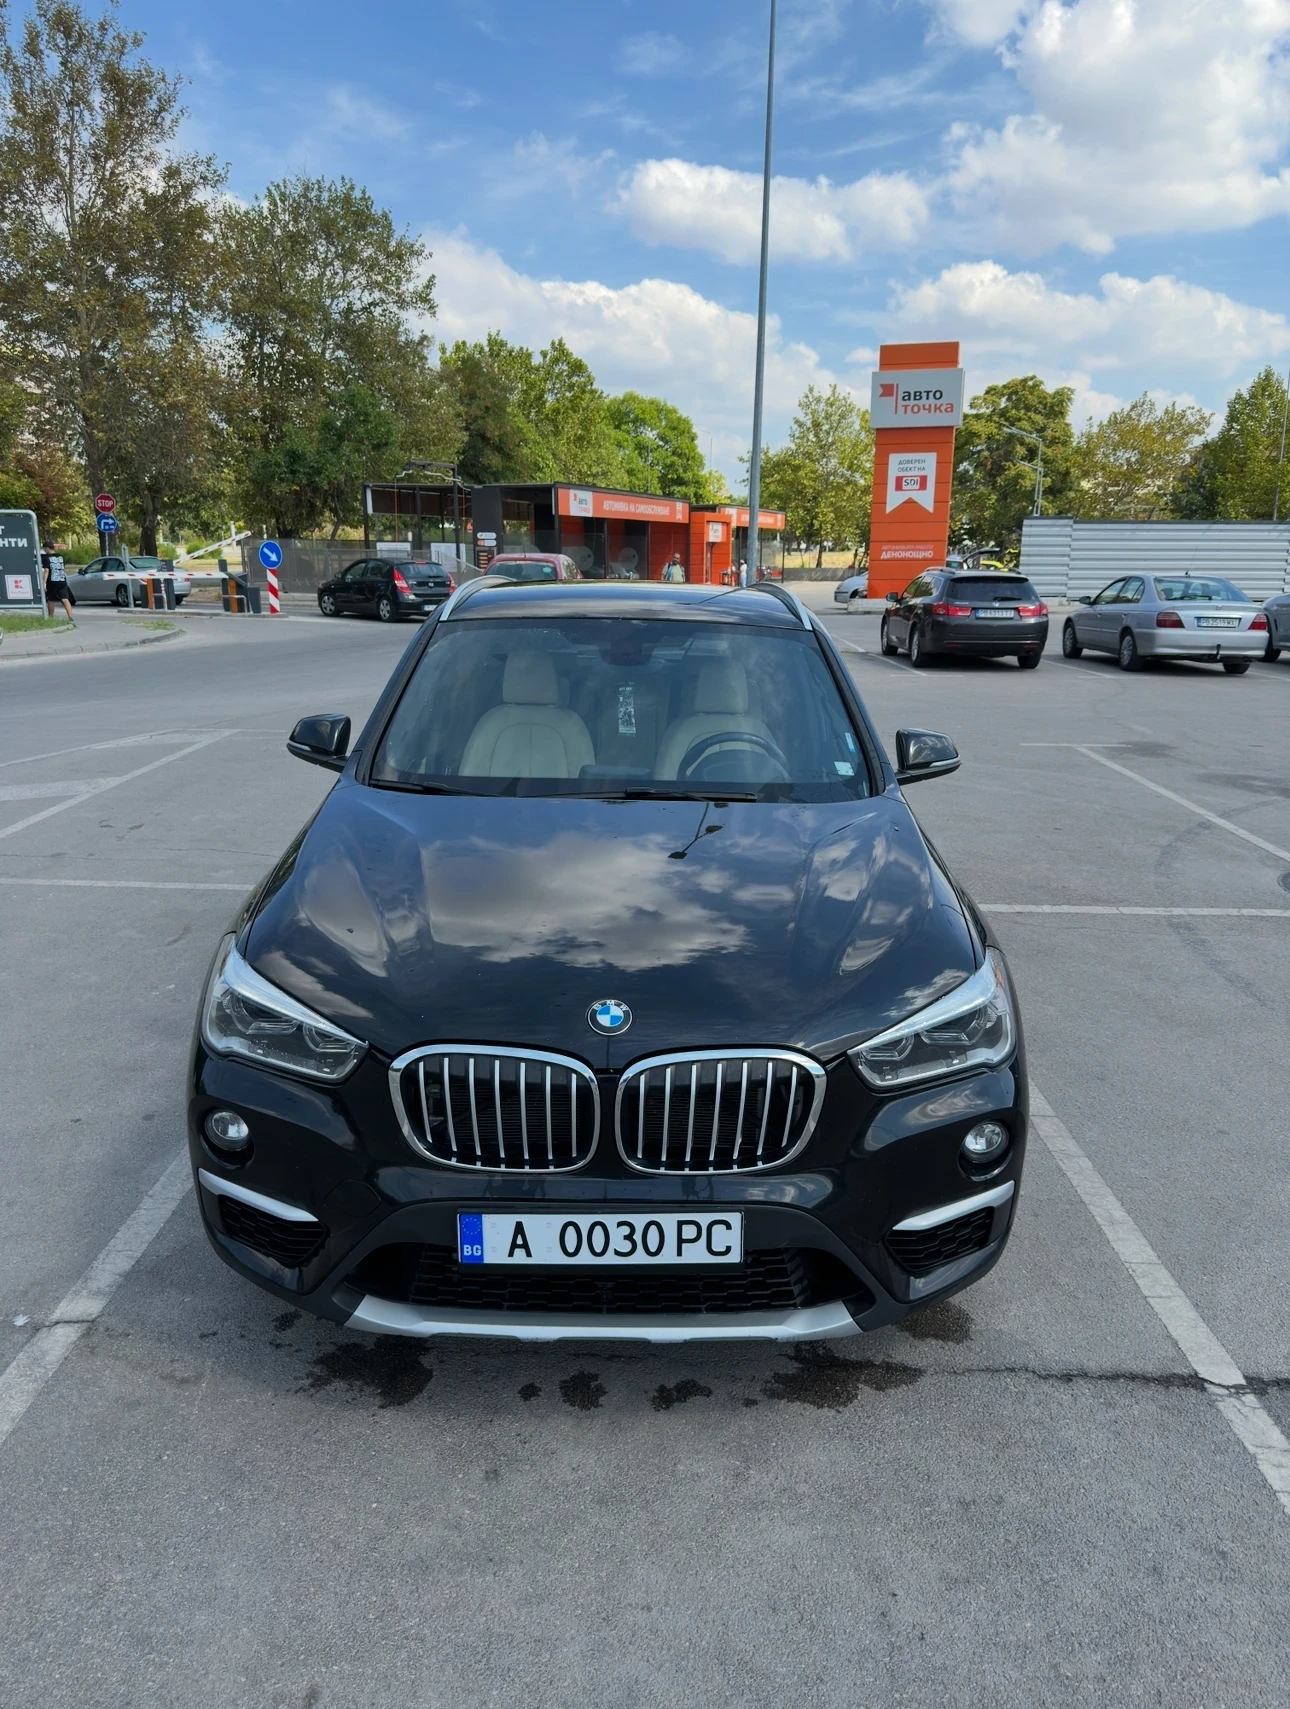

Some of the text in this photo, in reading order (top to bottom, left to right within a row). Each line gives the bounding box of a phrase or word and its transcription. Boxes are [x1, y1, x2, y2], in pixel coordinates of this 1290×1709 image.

[901, 388, 943, 401] авто
[901, 402, 955, 415] точка
[897, 458, 926, 466] ДОВЕРЕН
[903, 478, 919, 487] SDI
[880, 550, 934, 559] ДЕНОНОЩНО
[593, 1000, 629, 1011] BMW
[507, 1220, 533, 1258] A
[463, 1244, 482, 1256] BG
